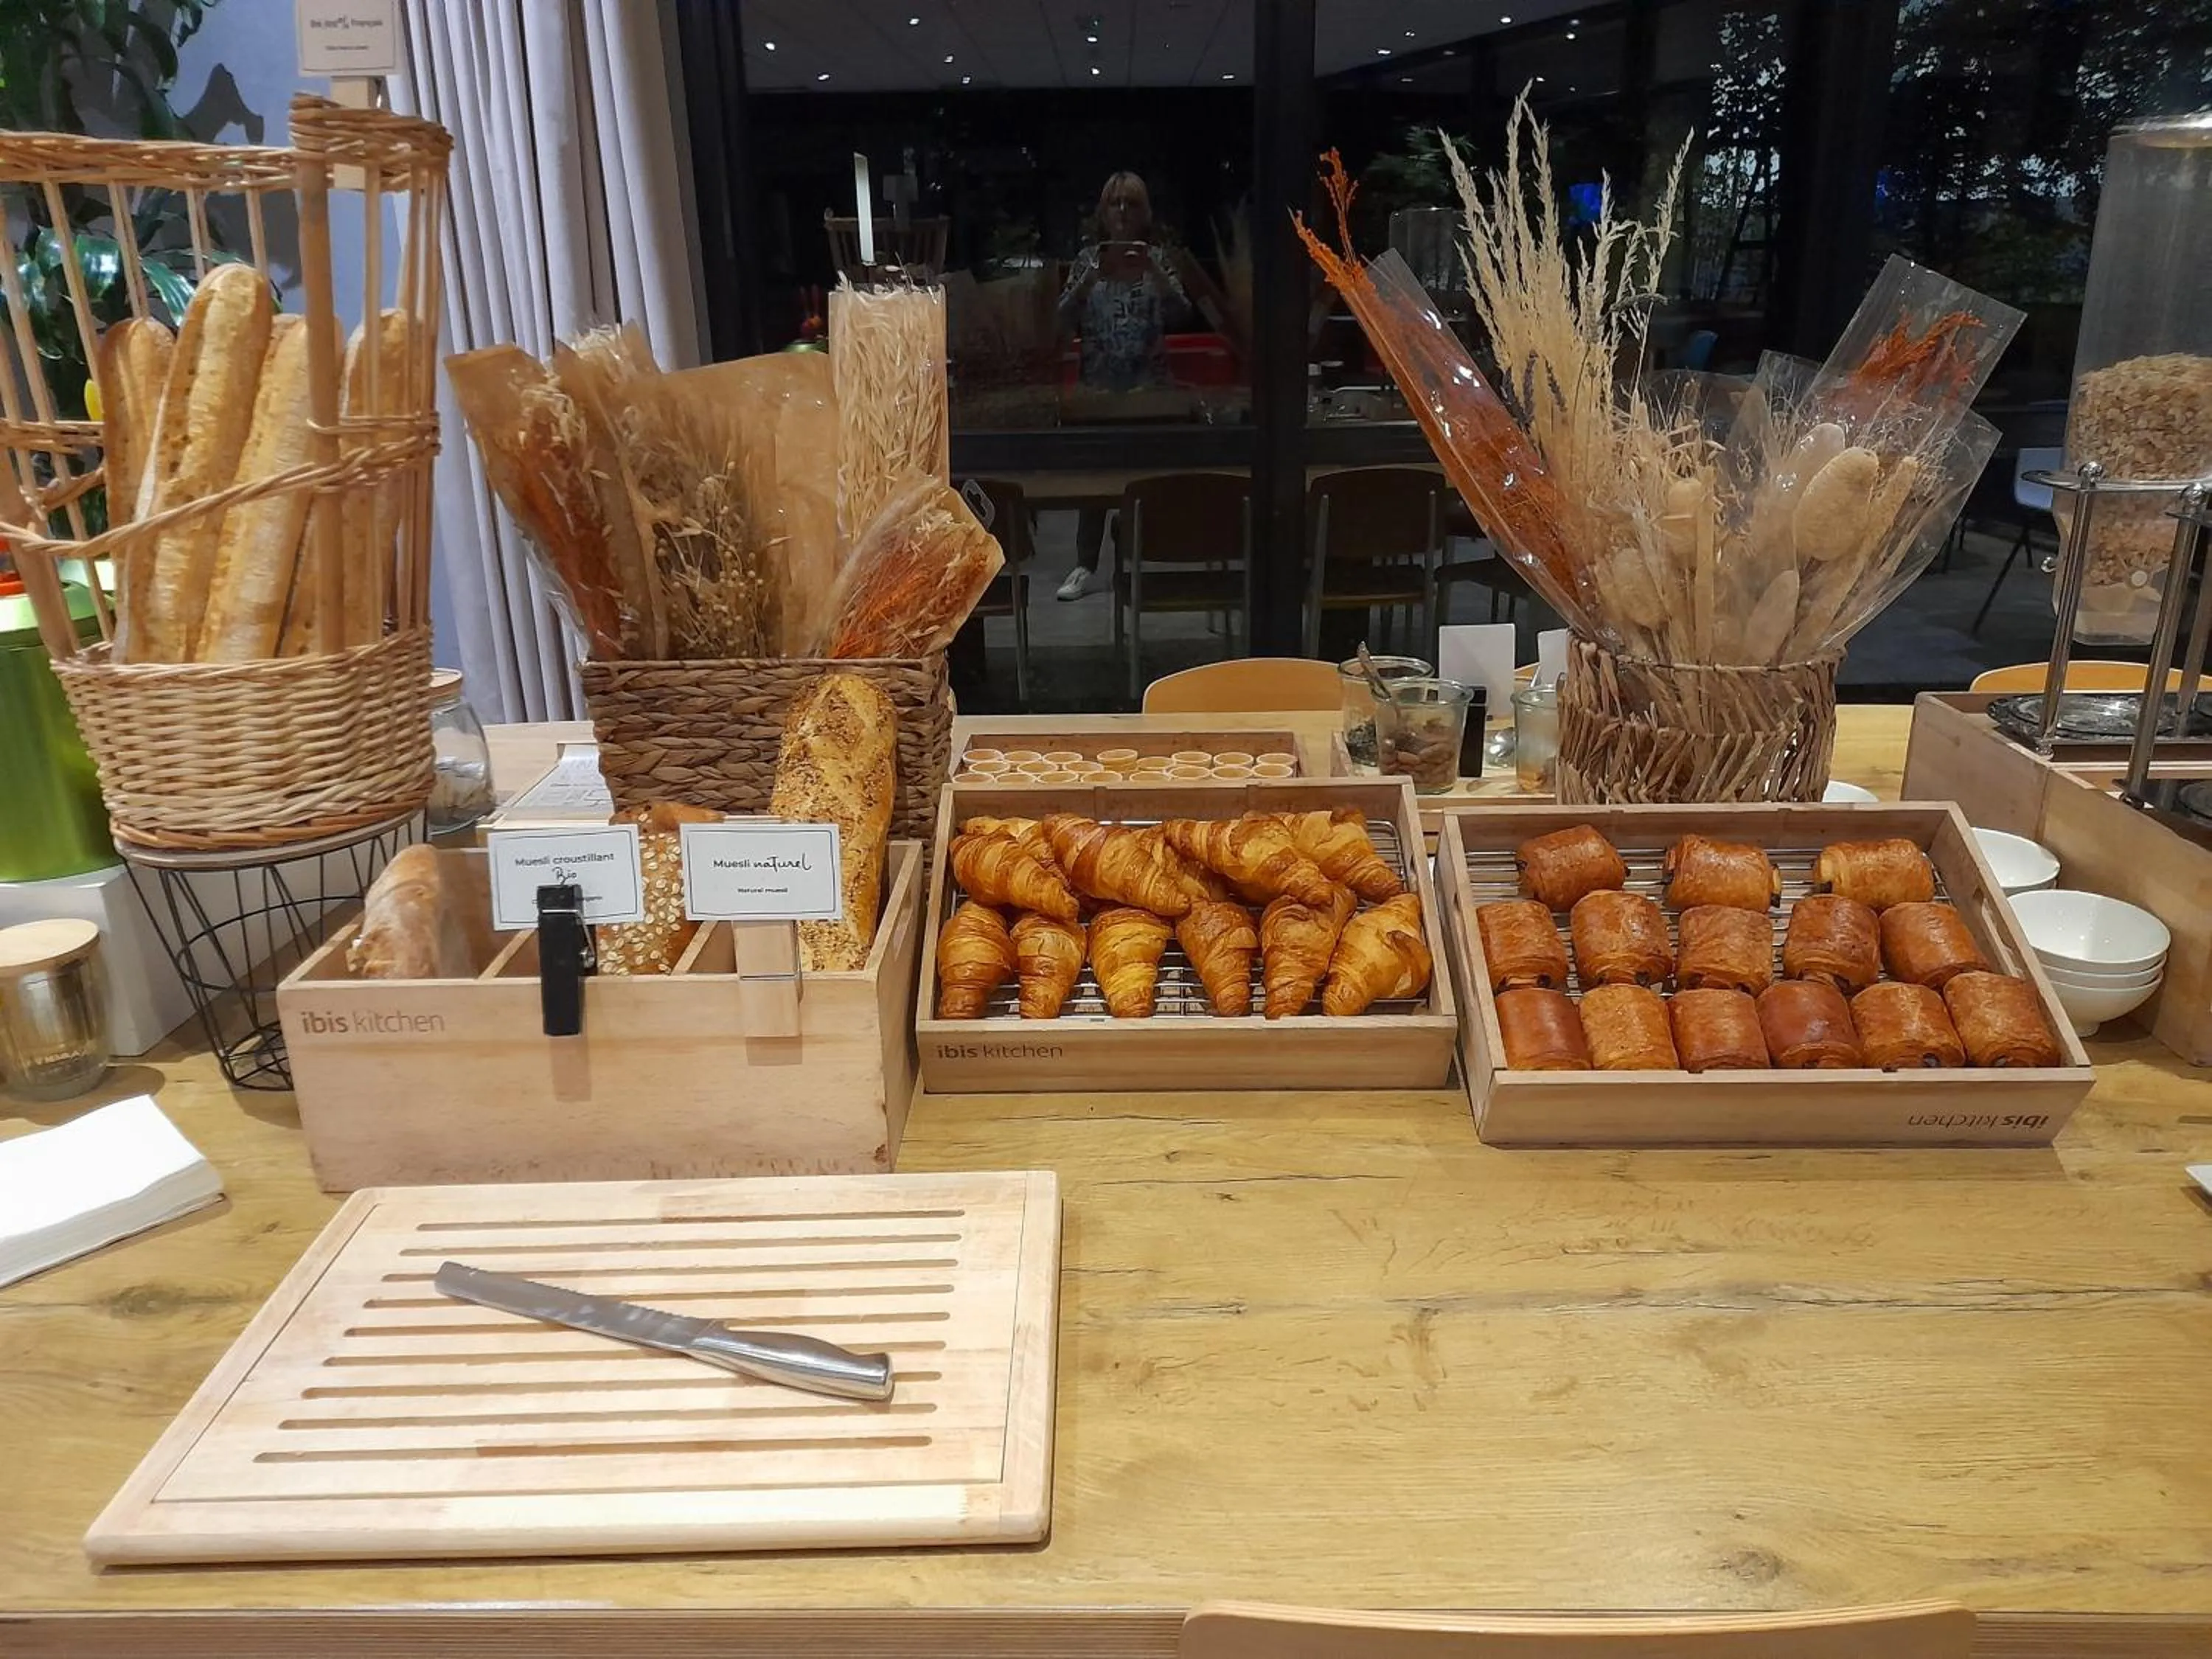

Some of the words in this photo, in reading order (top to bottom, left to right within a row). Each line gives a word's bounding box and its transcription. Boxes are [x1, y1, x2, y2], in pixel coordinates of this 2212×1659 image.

[515, 856, 550, 866] Muesli
[552, 853, 614, 864] croustillant
[712, 859, 751, 868] Muesli
[754, 852, 812, 872] naturel
[300, 1011, 349, 1034] ibis
[352, 1009, 445, 1033] kitchen
[936, 1044, 978, 1059] ibis
[982, 1043, 1063, 1059] kitchen
[1908, 1114, 1999, 1128] kitchen
[2000, 1114, 2050, 1130] ibis
